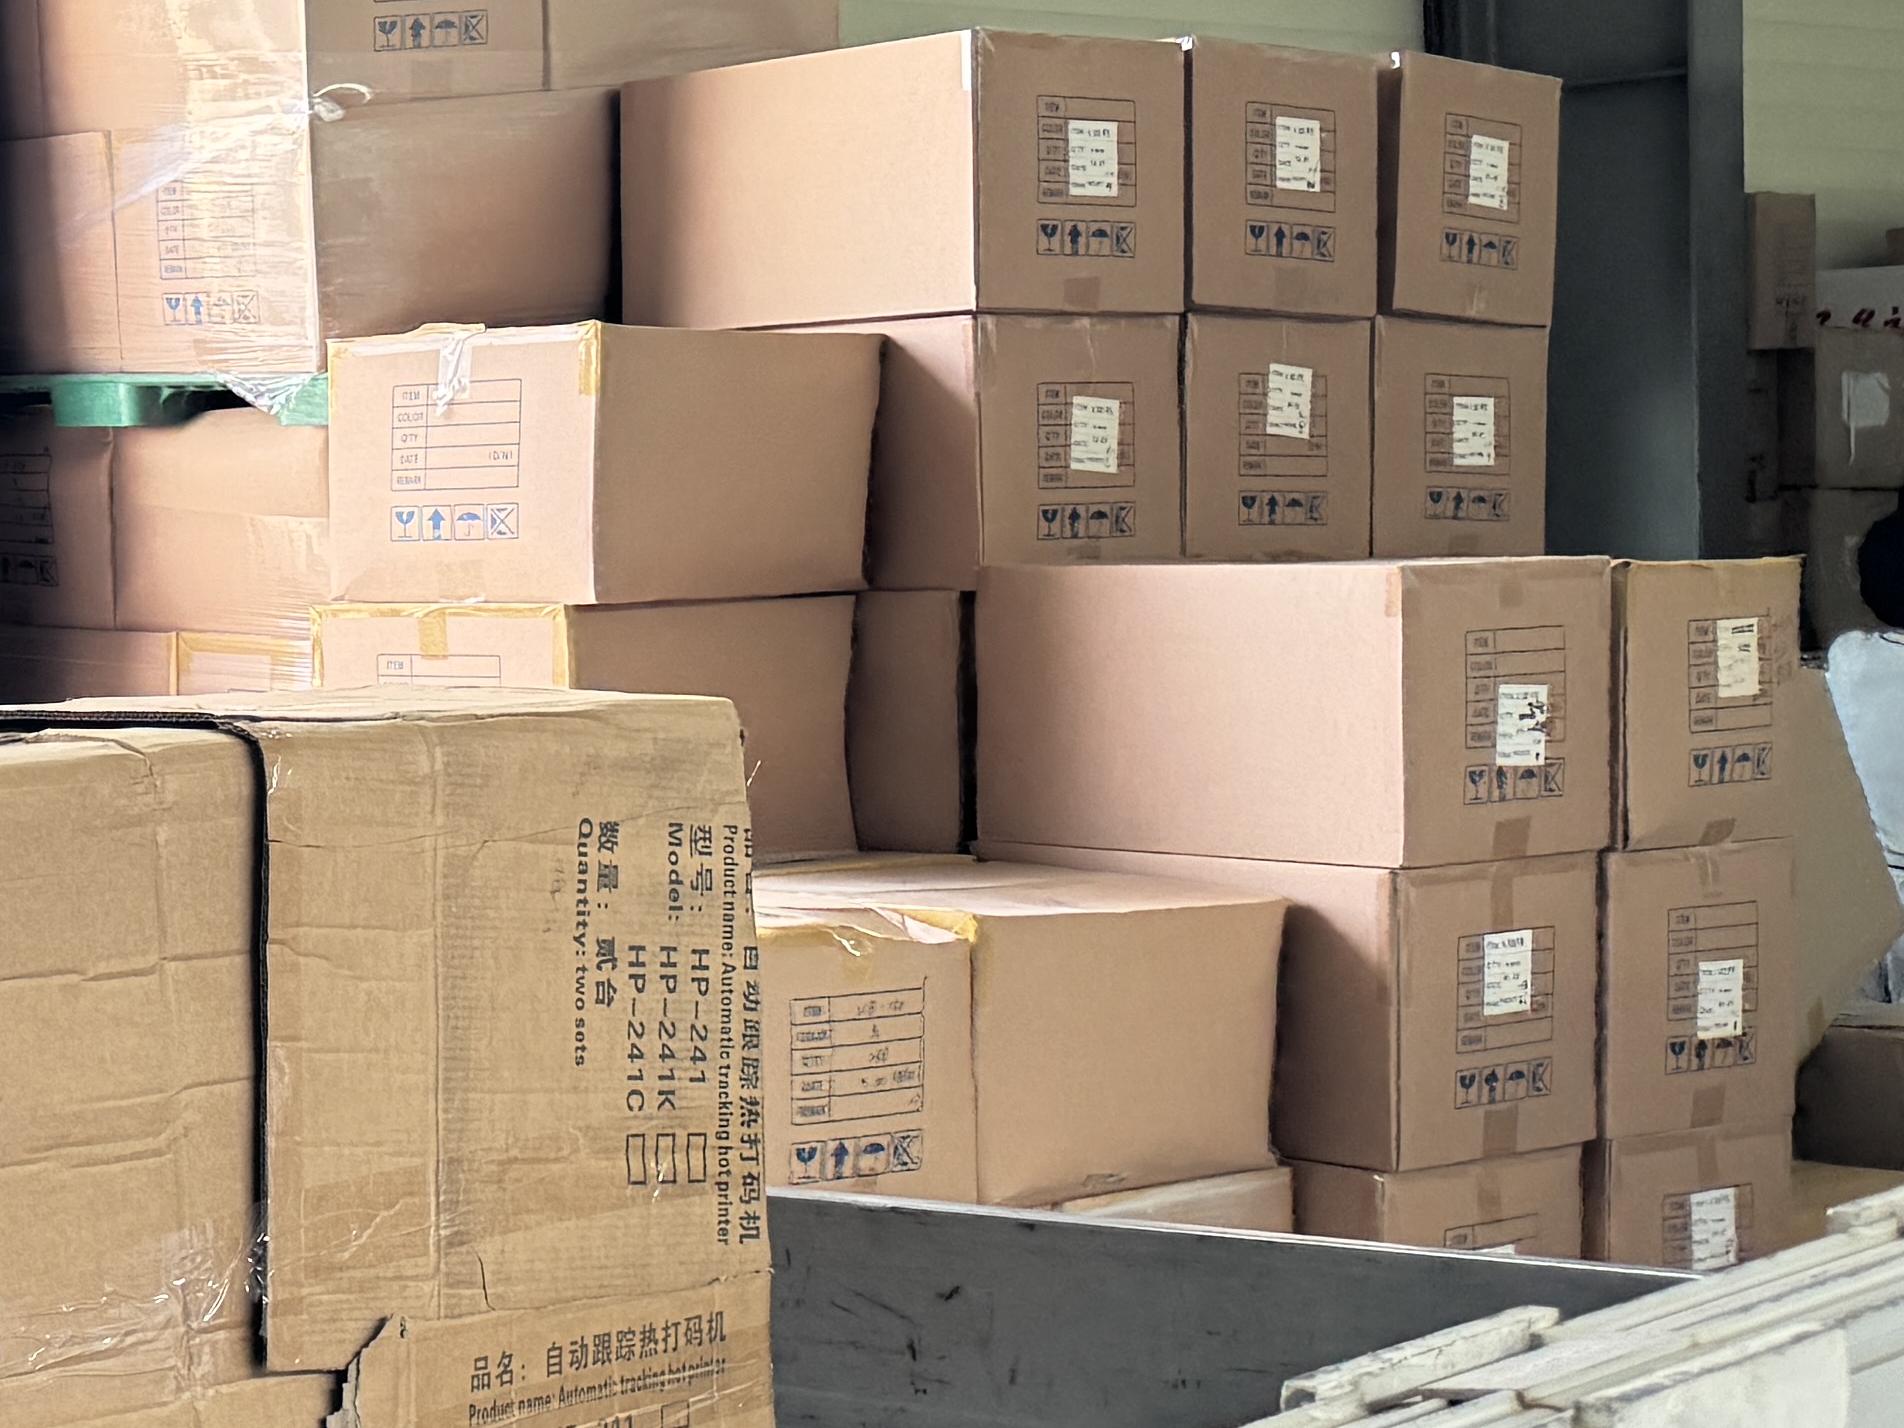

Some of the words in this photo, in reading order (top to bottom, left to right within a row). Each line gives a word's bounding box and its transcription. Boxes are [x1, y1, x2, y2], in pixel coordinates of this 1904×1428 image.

[573, 817, 593, 957] Quantity:
[667, 822, 684, 922] Model:
[722, 824, 738, 897] Product
[721, 901, 736, 957] name:
[574, 963, 590, 1011] two
[594, 936, 617, 1008] 贰台
[574, 1017, 590, 1067] sets
[626, 944, 647, 1113] HP-241C
[656, 945, 677, 1113] HP-241K
[689, 947, 710, 1084] HP-241
[720, 962, 737, 1060] Automatic
[715, 1063, 733, 1141] tracking
[717, 1145, 732, 1177] hot
[716, 1181, 731, 1246] printer
[546, 1311, 727, 1378] 自动跟踪热打码机
[468, 1399, 516, 1426] Product
[518, 1392, 556, 1414] name:
[558, 1381, 619, 1408] Automatic
